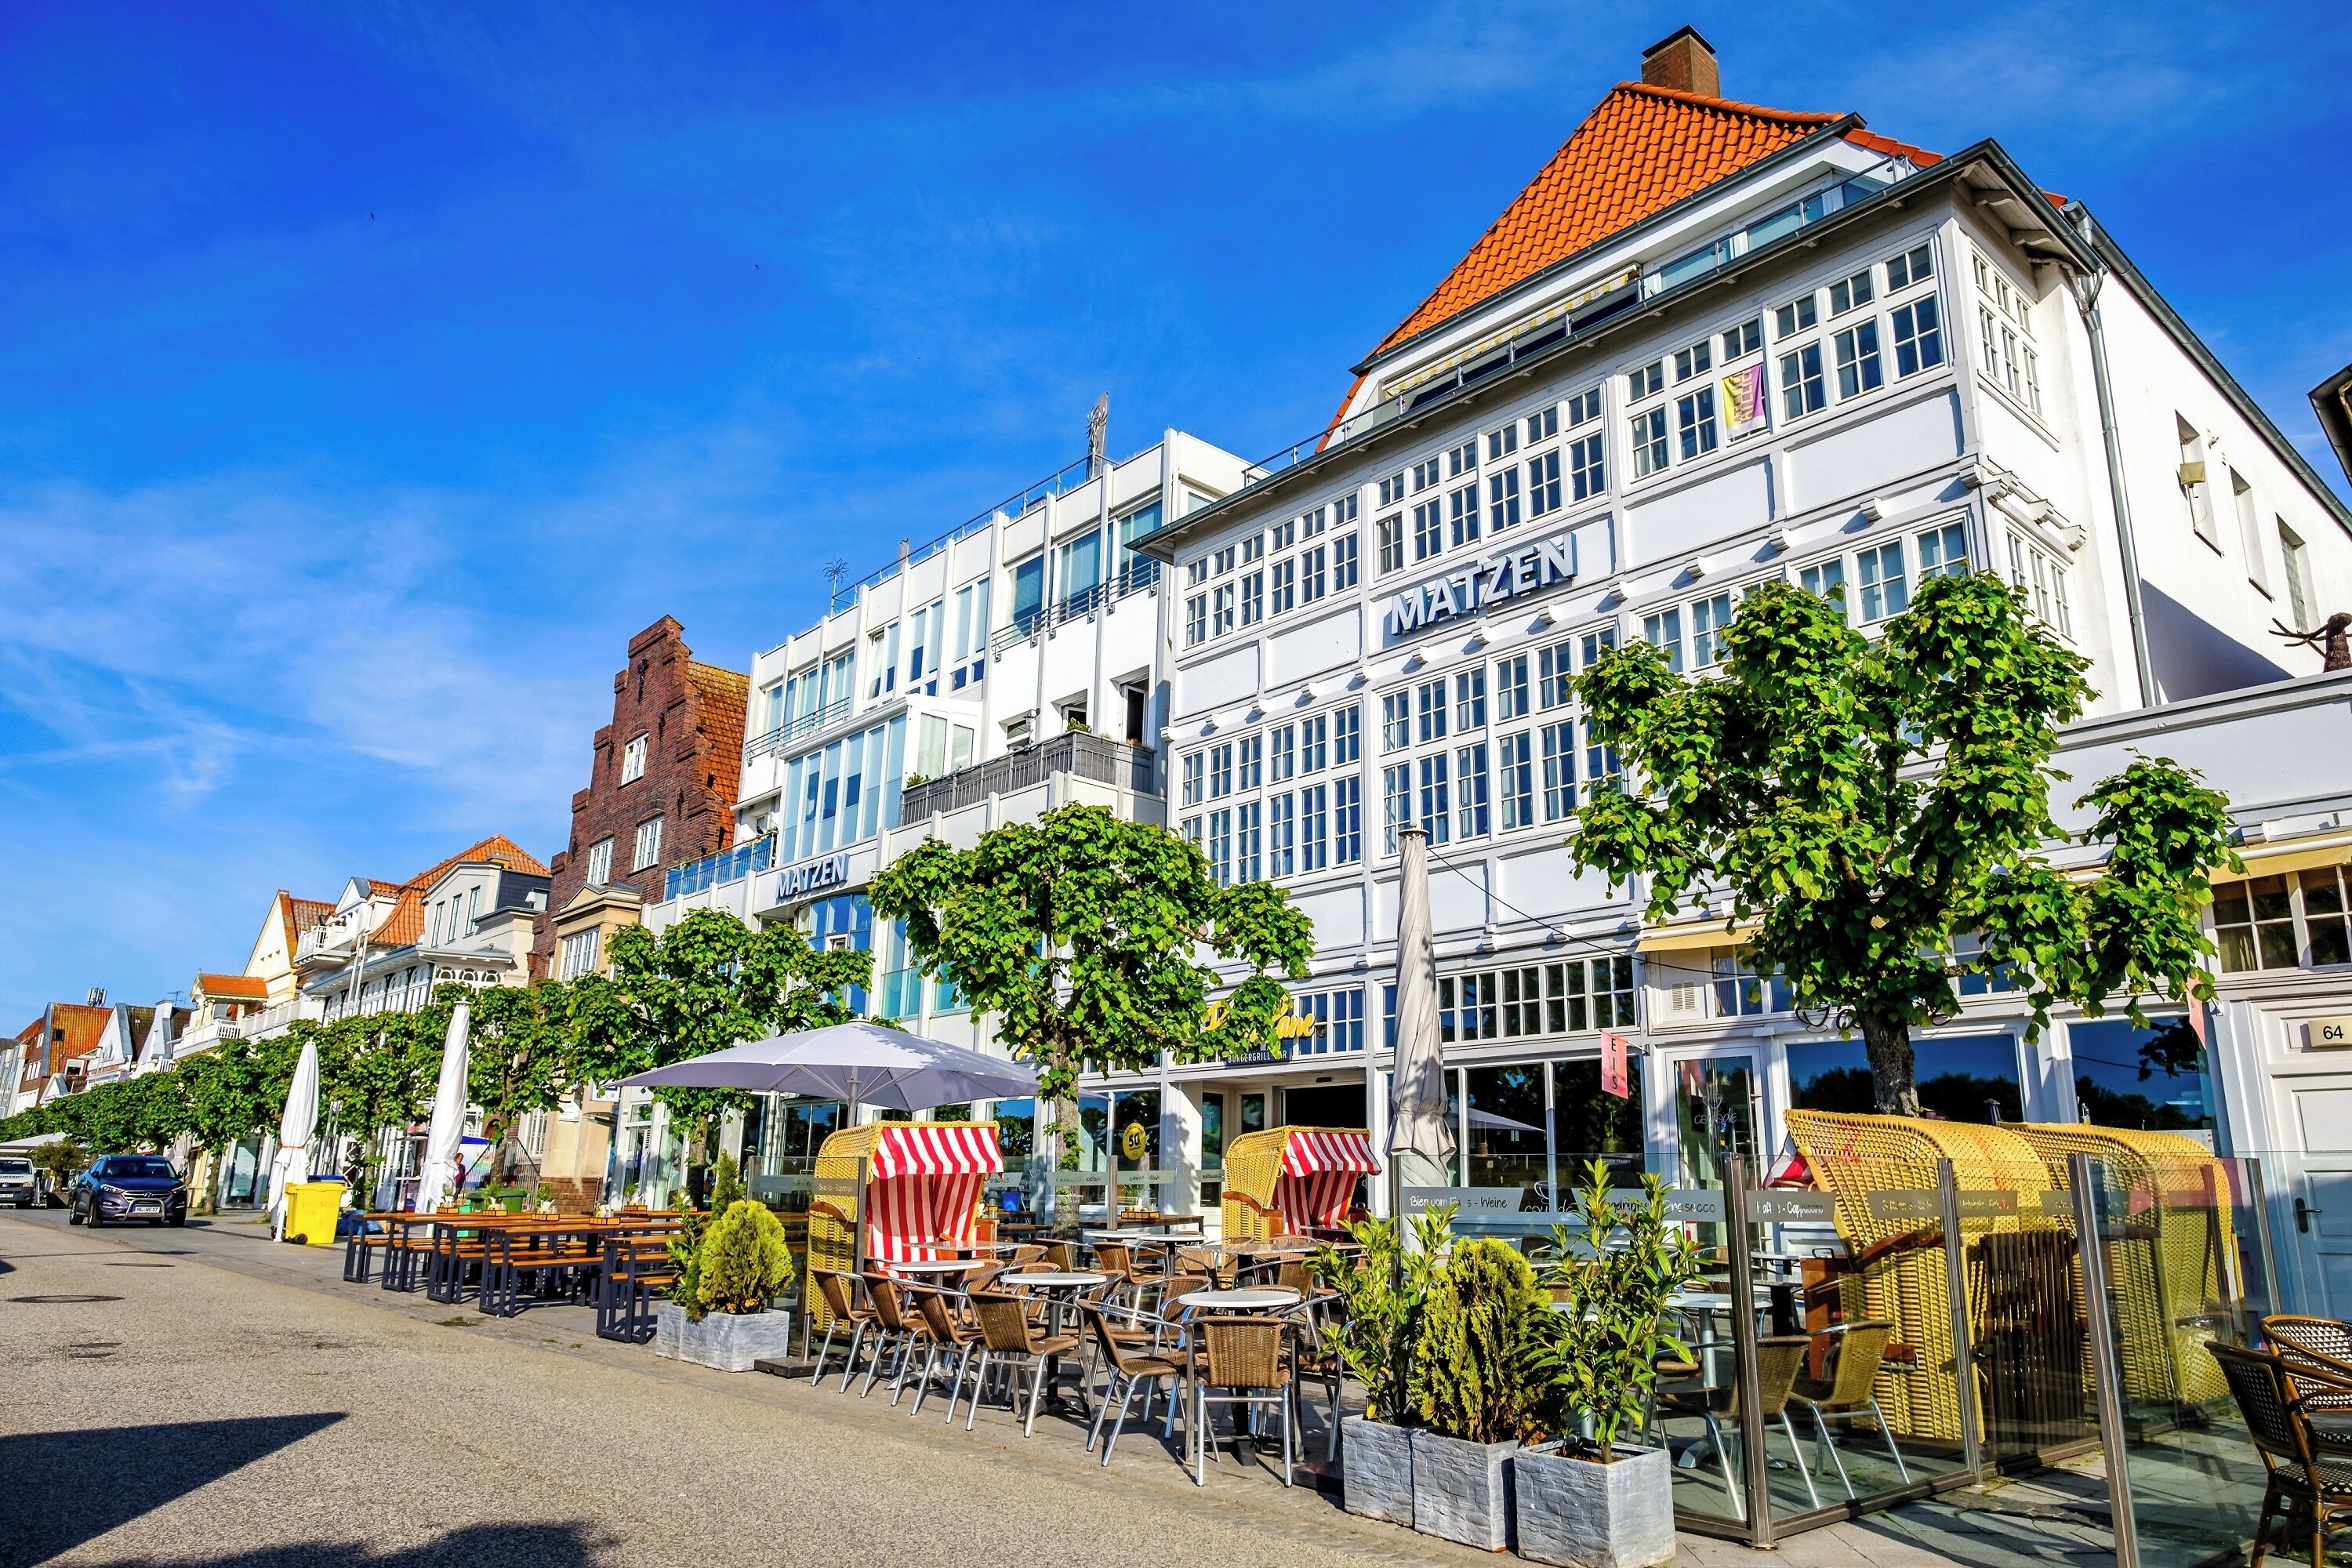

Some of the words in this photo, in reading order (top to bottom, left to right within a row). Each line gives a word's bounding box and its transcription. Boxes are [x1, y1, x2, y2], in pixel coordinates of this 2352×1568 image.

[1391, 532, 1578, 635] MATZEN
[776, 853, 850, 898] MATZEN
[2323, 1025, 2344, 1040] 64
[1480, 1196, 1508, 1208] Weine
[1663, 1200, 1715, 1214] Prosecco
[1787, 1201, 1824, 1218] Cappuccino
